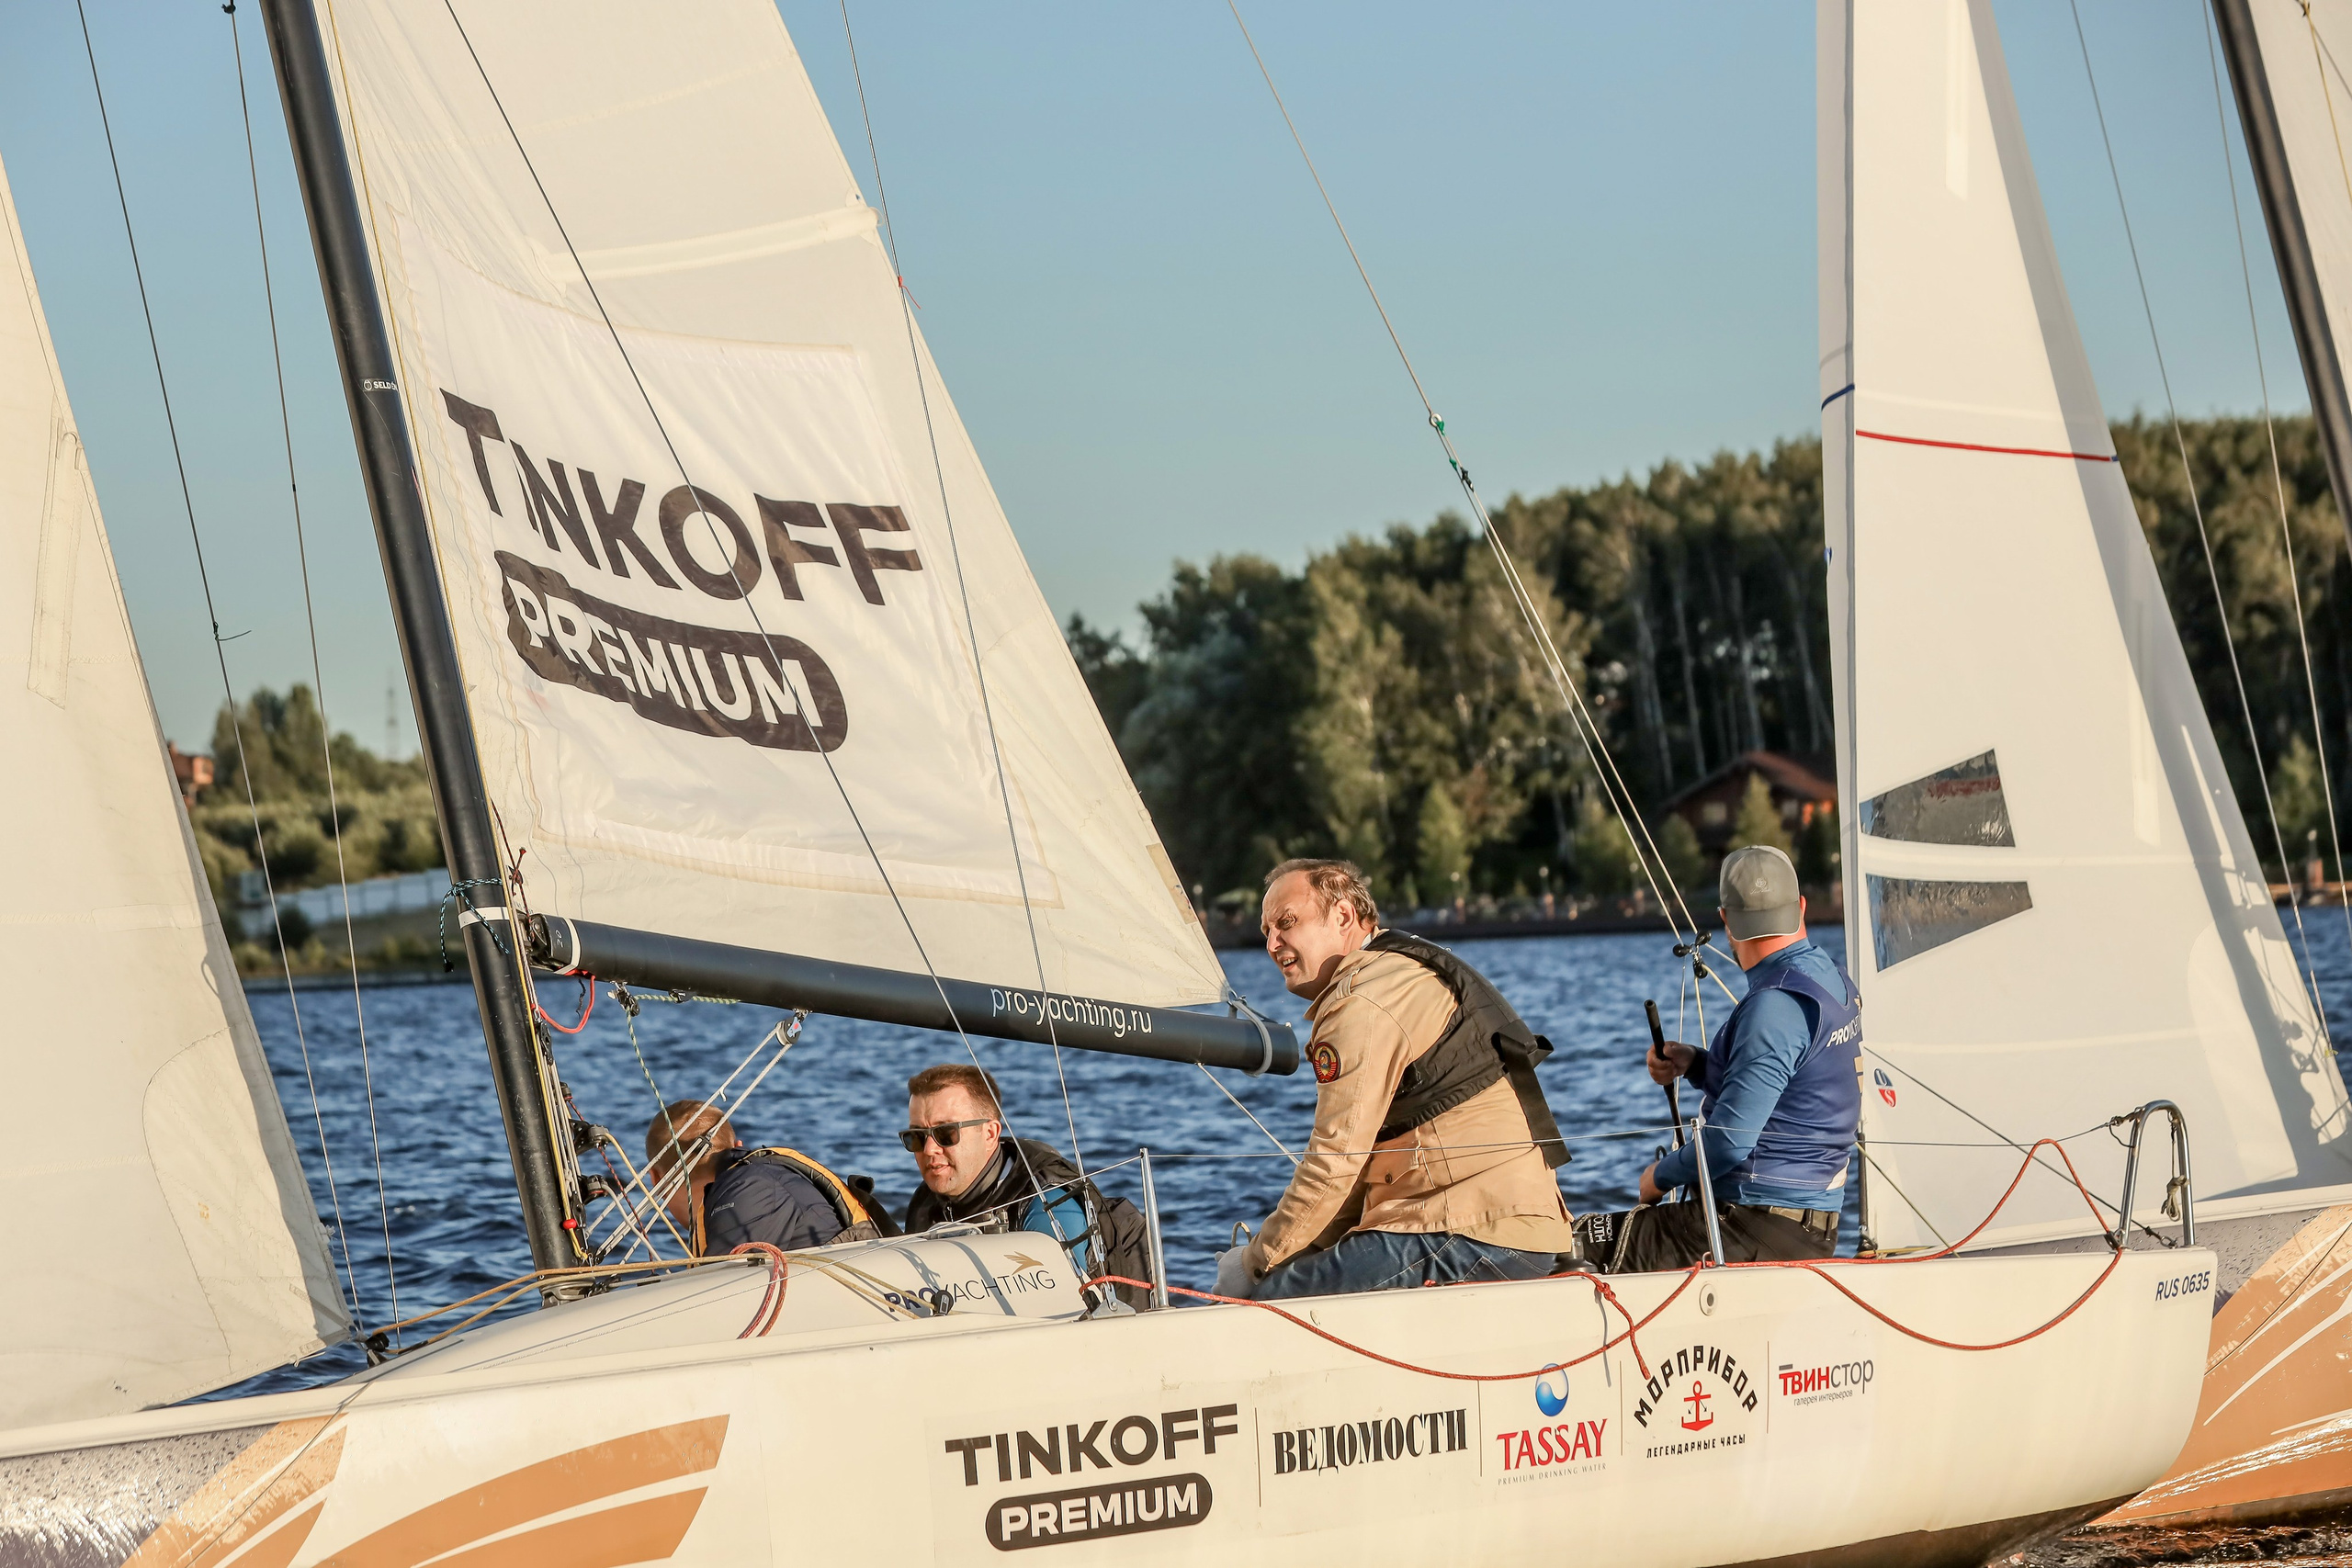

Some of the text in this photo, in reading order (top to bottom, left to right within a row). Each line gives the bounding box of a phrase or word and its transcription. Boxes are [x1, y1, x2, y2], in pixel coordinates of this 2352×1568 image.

[506, 575, 823, 728] PREMIUM
[989, 987, 1153, 1038] pro-yachting.ru
[2155, 1270, 2211, 1301] RUS 0635
[1634, 1345, 1758, 1428] МОРПРИБОР
[1793, 1389, 1853, 1406] галерея интерьеров
[944, 1404, 1238, 1486] TINKOFF
[1272, 1408, 1467, 1476] ВЕДОМОСТИ
[1496, 1418, 1608, 1471] TASSAY
[1646, 1433, 1746, 1459] ЛЕГЕНДАРНЫЕ ЧАСЫ
[1498, 1462, 1607, 1485] PREMIUM DRINKING WATER
[1001, 1481, 1199, 1542] PREMIUM
